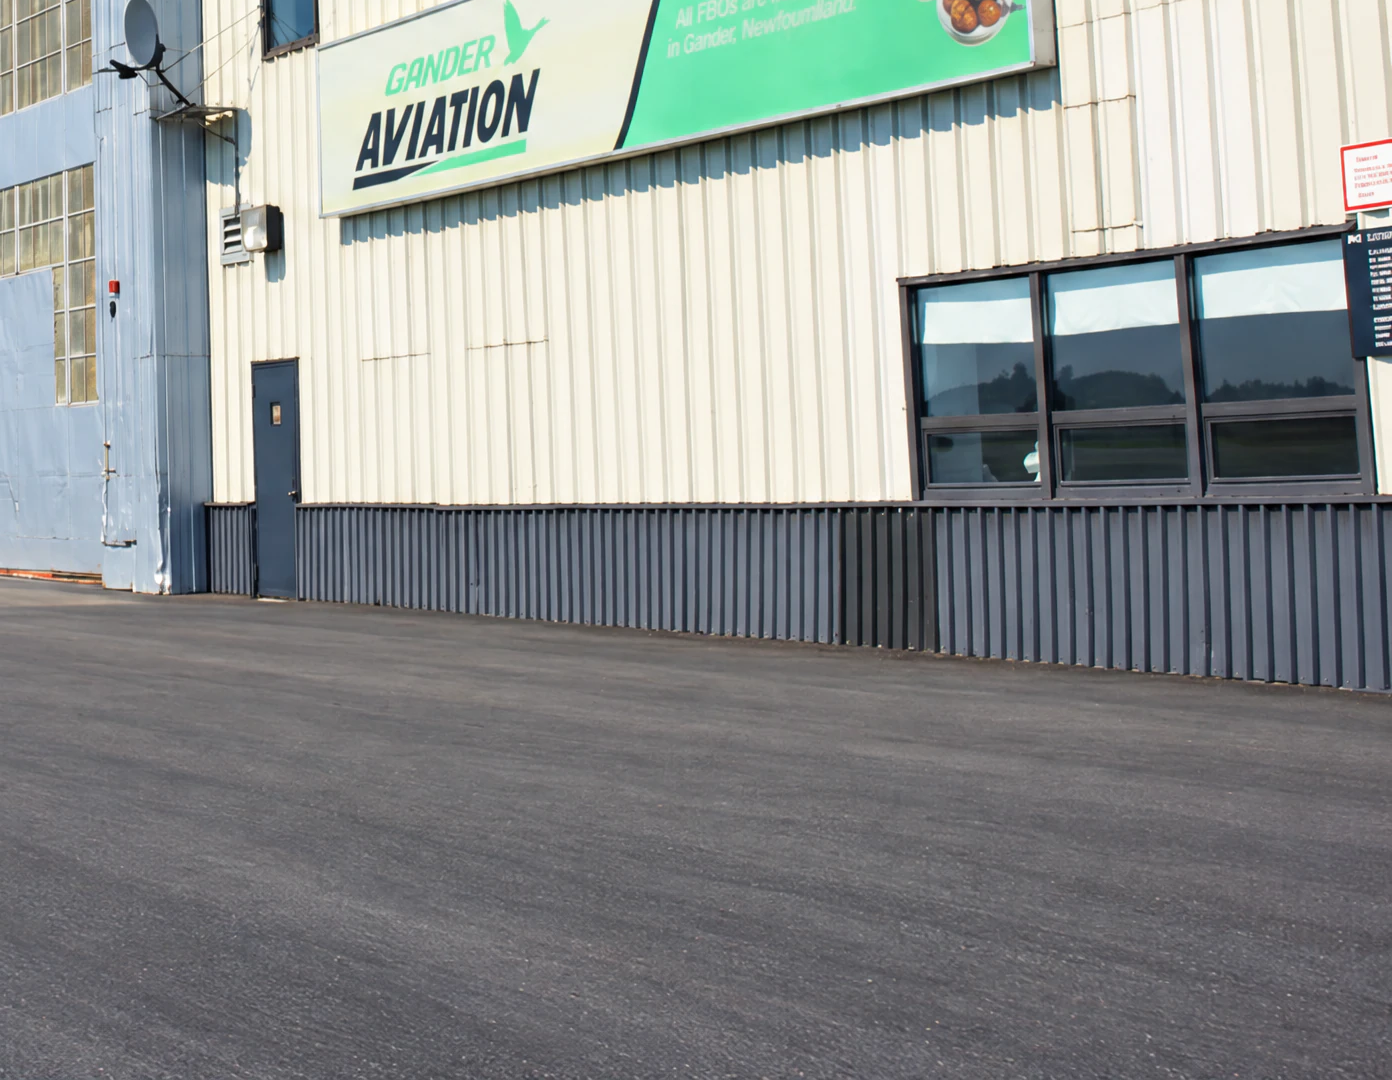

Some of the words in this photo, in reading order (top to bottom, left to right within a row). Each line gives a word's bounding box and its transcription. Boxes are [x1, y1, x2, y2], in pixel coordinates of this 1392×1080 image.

[675, 5, 693, 29] All
[384, 34, 496, 96] GANDER
[666, 37, 680, 59] in
[683, 26, 737, 55] Gander,
[355, 68, 541, 172] AVIATION
